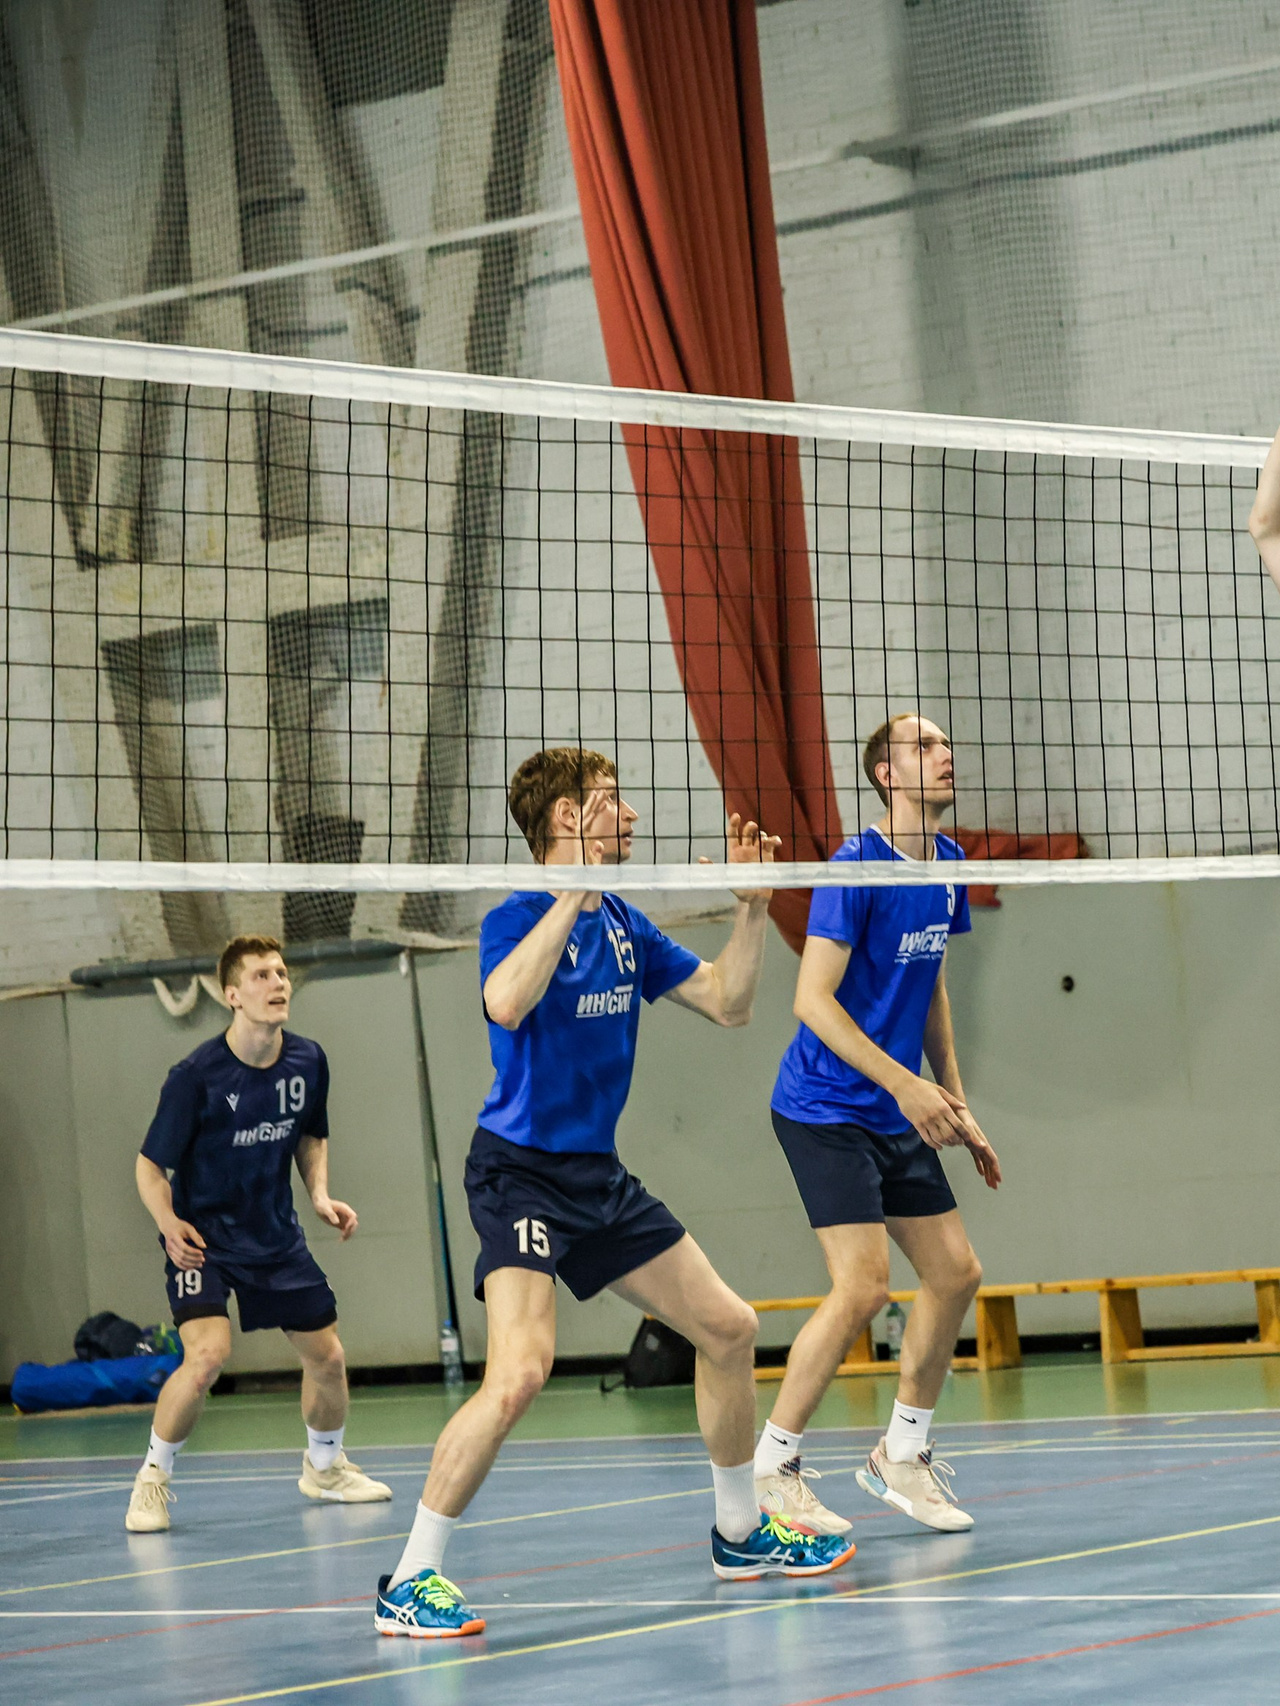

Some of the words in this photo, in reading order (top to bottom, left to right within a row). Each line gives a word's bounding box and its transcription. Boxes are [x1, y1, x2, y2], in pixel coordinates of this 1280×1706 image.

[607, 928, 637, 975] 15
[275, 1075, 306, 1115] 19
[512, 1216, 552, 1259] 15
[174, 1268, 203, 1299] 19
